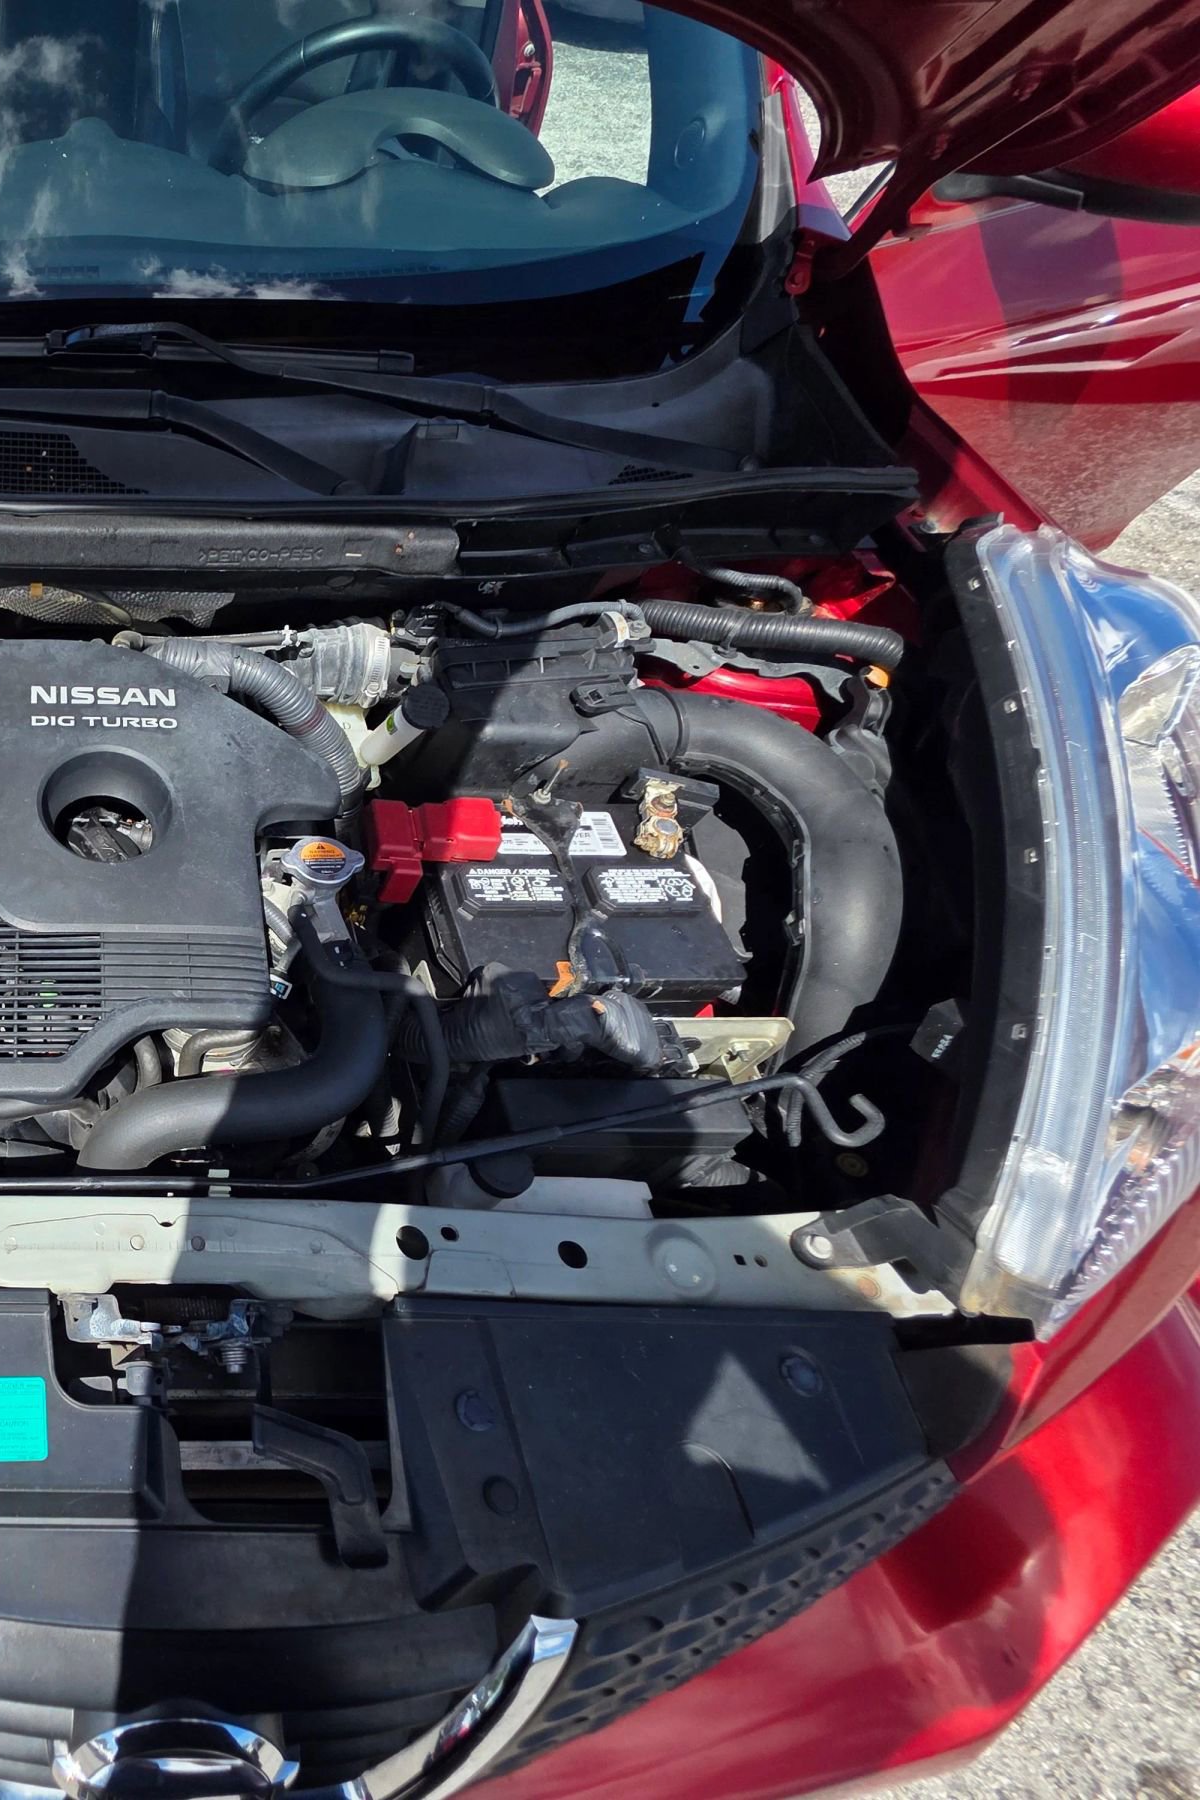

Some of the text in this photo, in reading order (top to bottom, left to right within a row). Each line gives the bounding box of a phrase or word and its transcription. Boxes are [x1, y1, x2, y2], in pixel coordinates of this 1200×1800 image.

[30, 685, 176, 707] NISSAN
[31, 715, 178, 729] DIG TURBO
